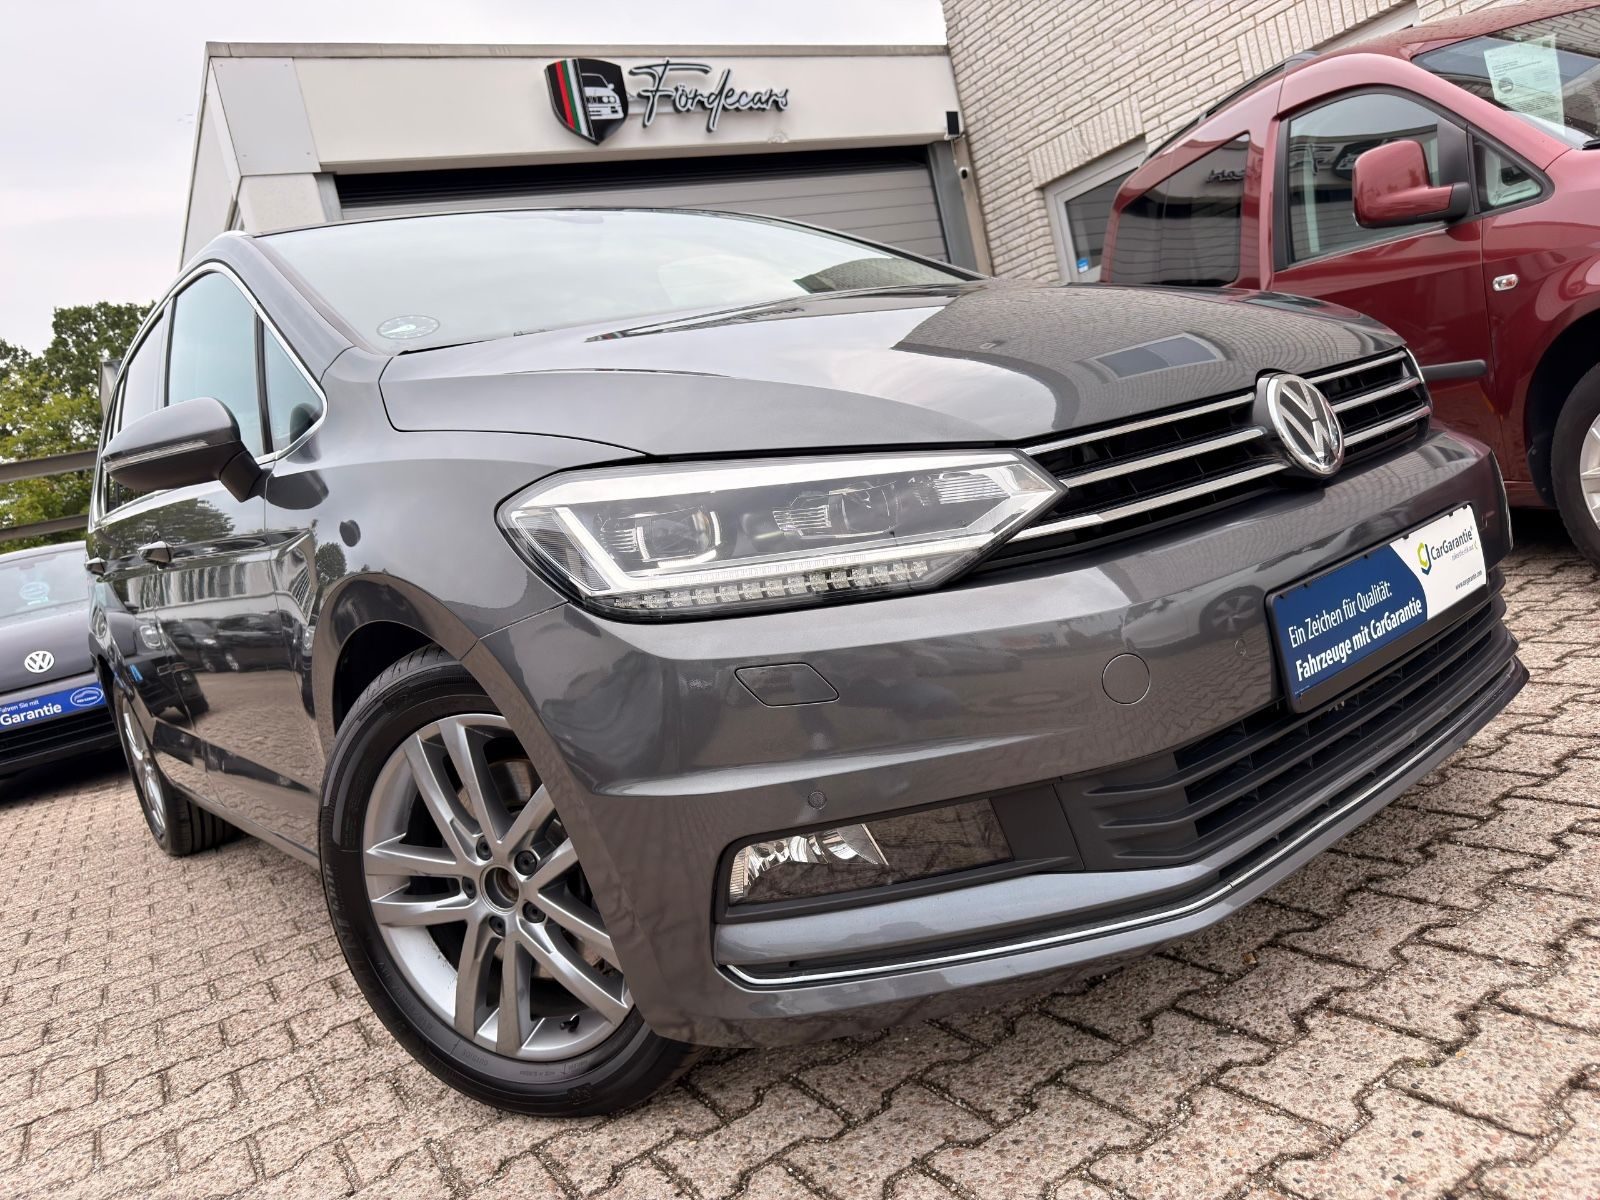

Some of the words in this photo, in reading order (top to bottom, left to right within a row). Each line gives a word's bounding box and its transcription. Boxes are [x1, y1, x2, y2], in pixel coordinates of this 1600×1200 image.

[628, 58, 789, 133] Fördecars
[1430, 528, 1473, 561] CarGarantie
[1288, 625, 1307, 649] Ein
[1304, 609, 1344, 641] Zeichen
[1342, 598, 1357, 621] für
[1356, 580, 1393, 613] Qualität:
[1295, 638, 1353, 682] Fahrzeuge
[1352, 625, 1372, 651] mit
[1370, 596, 1423, 640] CarGarantie
[0, 702, 62, 726] Garantie
